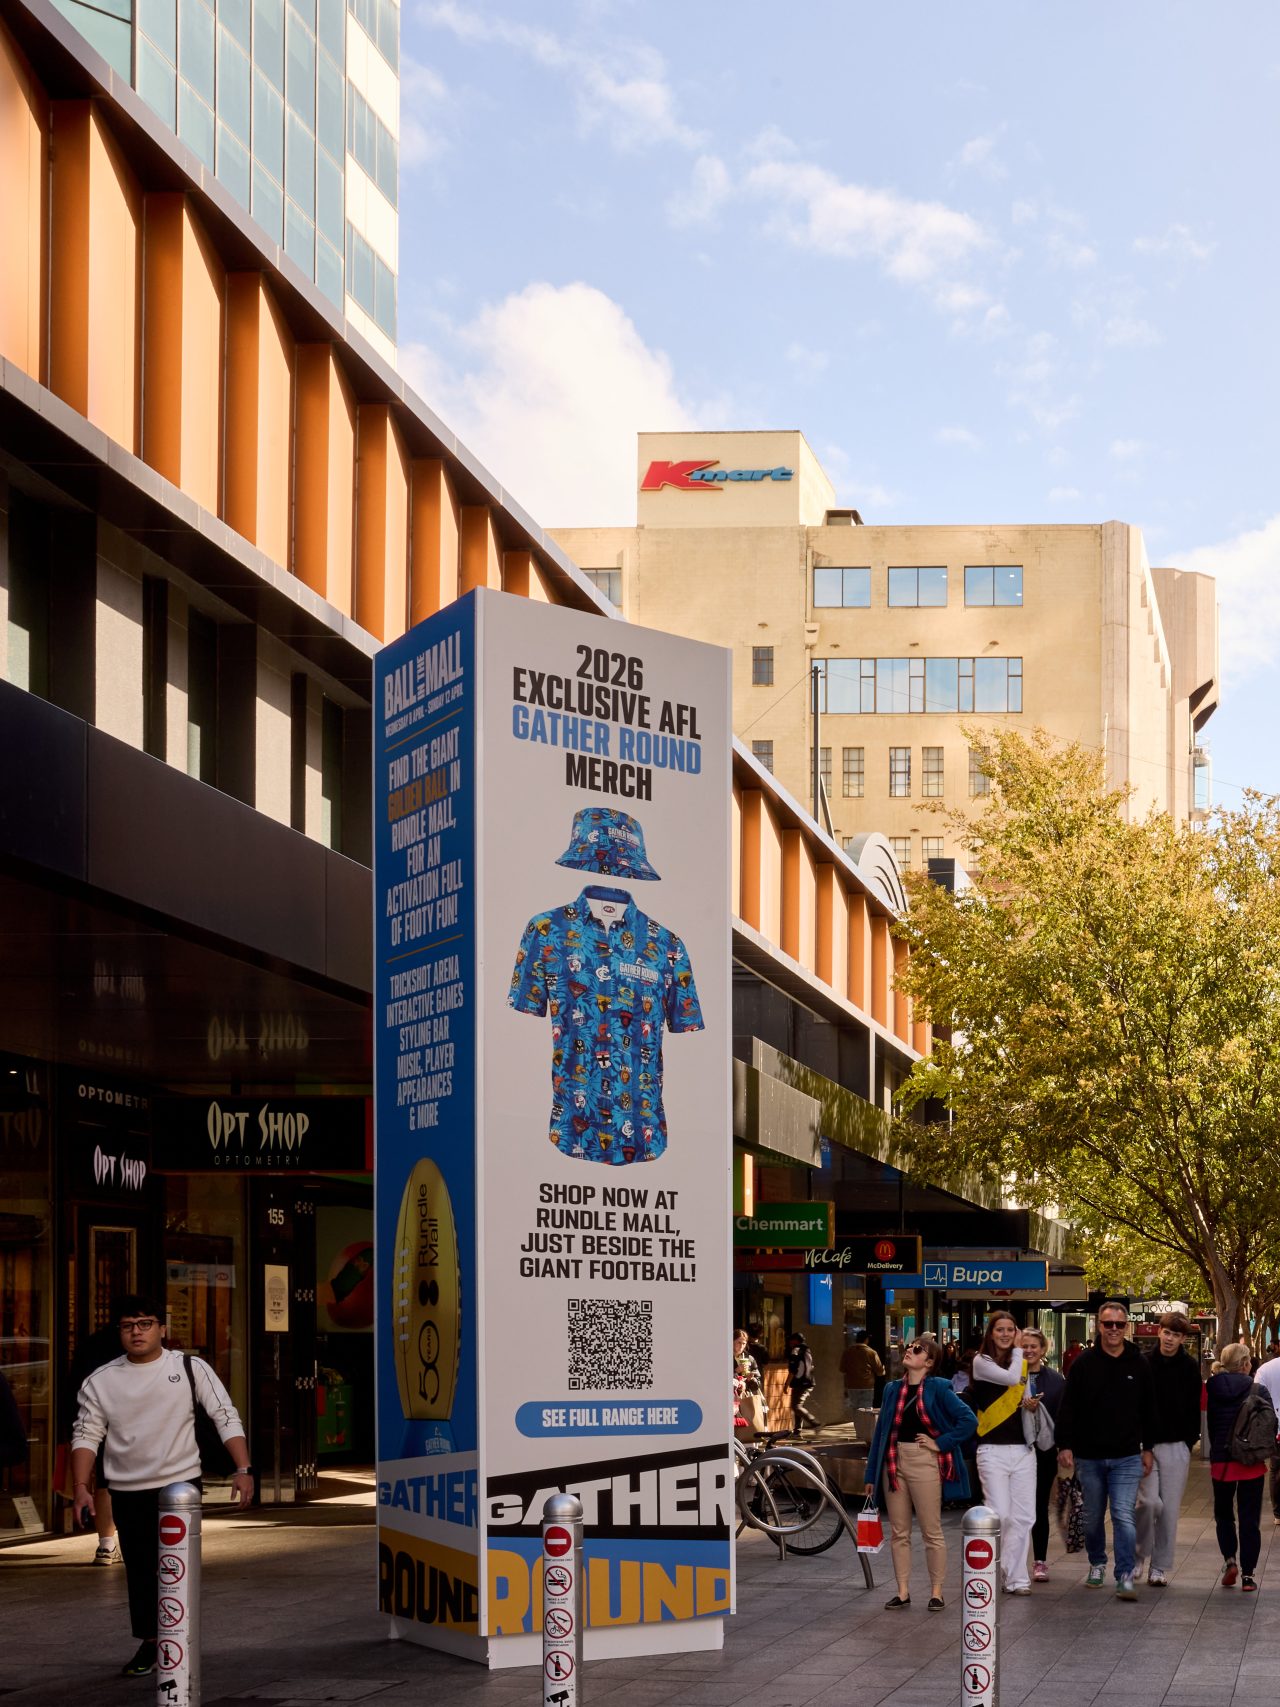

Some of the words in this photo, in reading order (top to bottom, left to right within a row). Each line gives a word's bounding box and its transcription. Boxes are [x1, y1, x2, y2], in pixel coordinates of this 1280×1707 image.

[640, 461, 794, 491] Kmart
[384, 660, 416, 720] BALL
[424, 630, 464, 696] MALL
[576, 645, 644, 691] 2026
[513, 666, 651, 729] EXCLUSIVE
[659, 700, 701, 740] AFL
[389, 755, 409, 791] FIND
[412, 744, 429, 779] THE
[431, 726, 460, 770] GIANT
[512, 704, 609, 756] GATHER
[619, 727, 701, 775] ROUND
[388, 779, 422, 822] GOLDEN
[425, 768, 448, 805] BALL
[450, 759, 461, 793] IN
[565, 753, 652, 801] MERCH
[392, 810, 427, 852] RUNDLE
[429, 797, 456, 836] MALL,
[407, 843, 425, 877] FOR
[427, 835, 441, 869] AN
[387, 869, 439, 917] ACTIVATION
[442, 859, 464, 895] FULL
[391, 915, 403, 946] OF
[405, 903, 434, 942] FOOTY
[436, 893, 458, 930] FUN!
[390, 963, 431, 999] TRICKSHOT
[433, 954, 460, 986] ARENA
[386, 991, 434, 1028] INTERACTIVE
[436, 982, 464, 1014] GAMES
[400, 1022, 431, 1052] STYLING
[433, 1016, 449, 1042] BAR
[397, 1051, 424, 1080] MUSIC,
[425, 1043, 455, 1073] PLAYER
[397, 1071, 453, 1107] APPEARANCES
[409, 1107, 416, 1131] &
[417, 1102, 439, 1129] MORE
[214, 1155, 301, 1166] OPTOMETRY
[267, 1209, 284, 1225] 155
[539, 1183, 596, 1205] SHOP
[602, 1187, 649, 1209] NOW
[655, 1190, 679, 1210] AT
[418, 1183, 428, 1268] Rundle
[430, 1218, 439, 1267] Mall
[536, 1208, 617, 1231] RUNDLE
[623, 1213, 681, 1237] MALL,
[736, 1216, 824, 1232] Chemmart
[520, 1233, 575, 1253] JUST
[582, 1235, 653, 1257] BESIDE
[658, 1238, 696, 1259] THE
[867, 1261, 904, 1271] McDelivery
[519, 1257, 583, 1279] GIANT
[589, 1260, 696, 1283] FOOTBALL!
[952, 1266, 1003, 1285] Bupa
[1143, 1304, 1174, 1313] novo
[418, 1320, 440, 1405] 50
[542, 1408, 567, 1428] SEE
[569, 1408, 599, 1427] FULL
[602, 1407, 645, 1426] RANGE
[647, 1407, 679, 1425] HERE
[379, 1469, 479, 1528] GATHER
[487, 1549, 730, 1636] RUND
